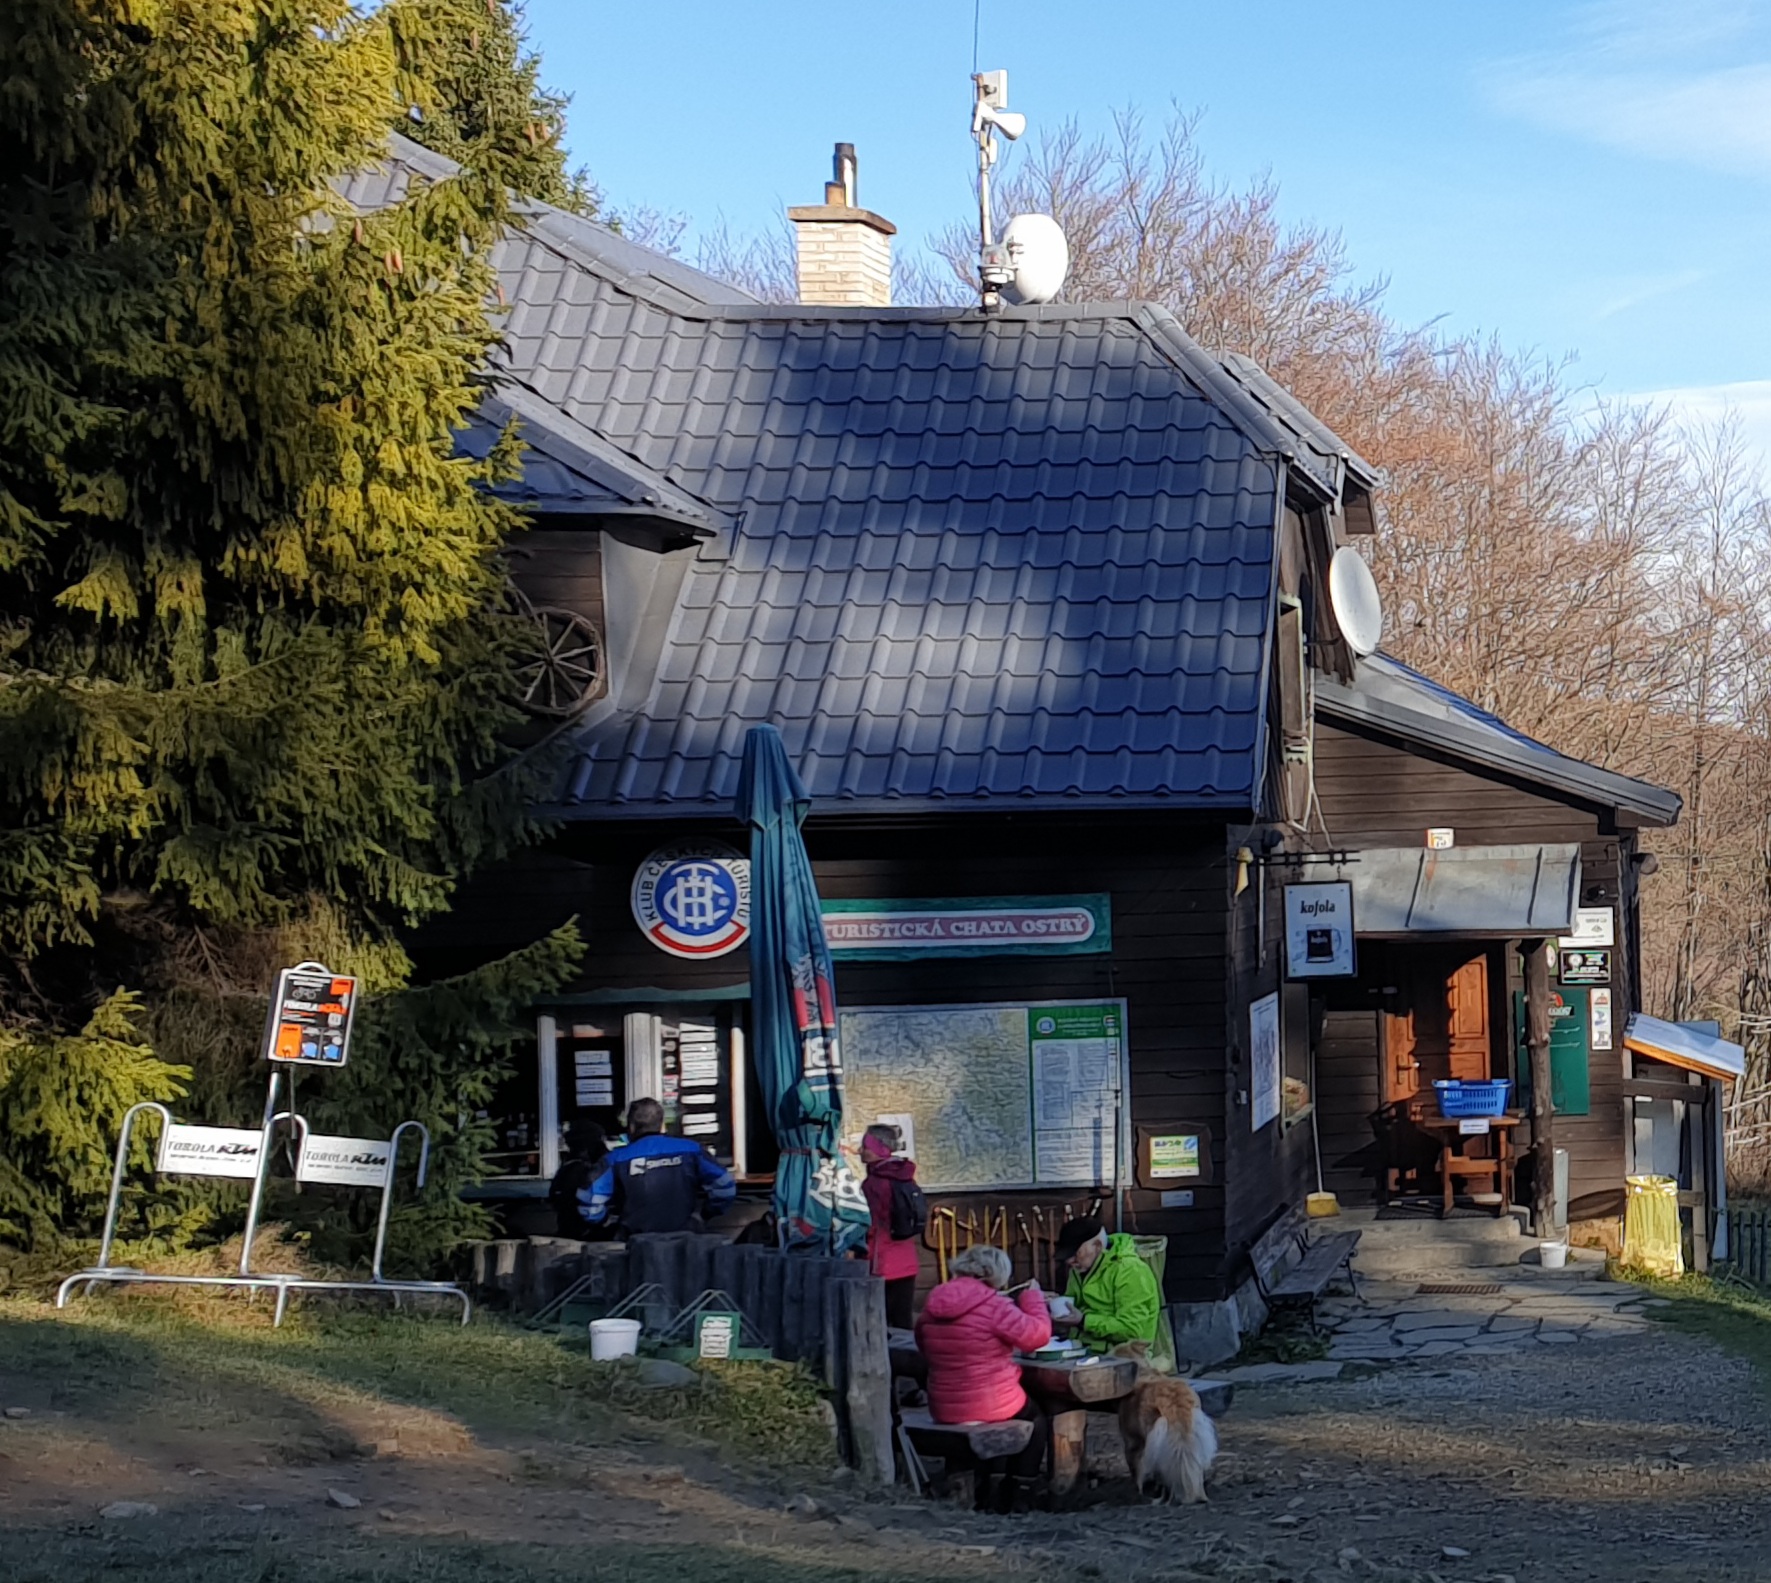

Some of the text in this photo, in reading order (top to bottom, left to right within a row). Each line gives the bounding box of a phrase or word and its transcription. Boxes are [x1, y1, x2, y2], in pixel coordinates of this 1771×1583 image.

[641, 880, 658, 921] KLUB
[1300, 899, 1336, 917] kofola
[824, 914, 1087, 939] TURISTICKÁ CHATA OSTRÝ
[216, 1143, 259, 1155] KTM
[351, 1152, 387, 1165] KTM
